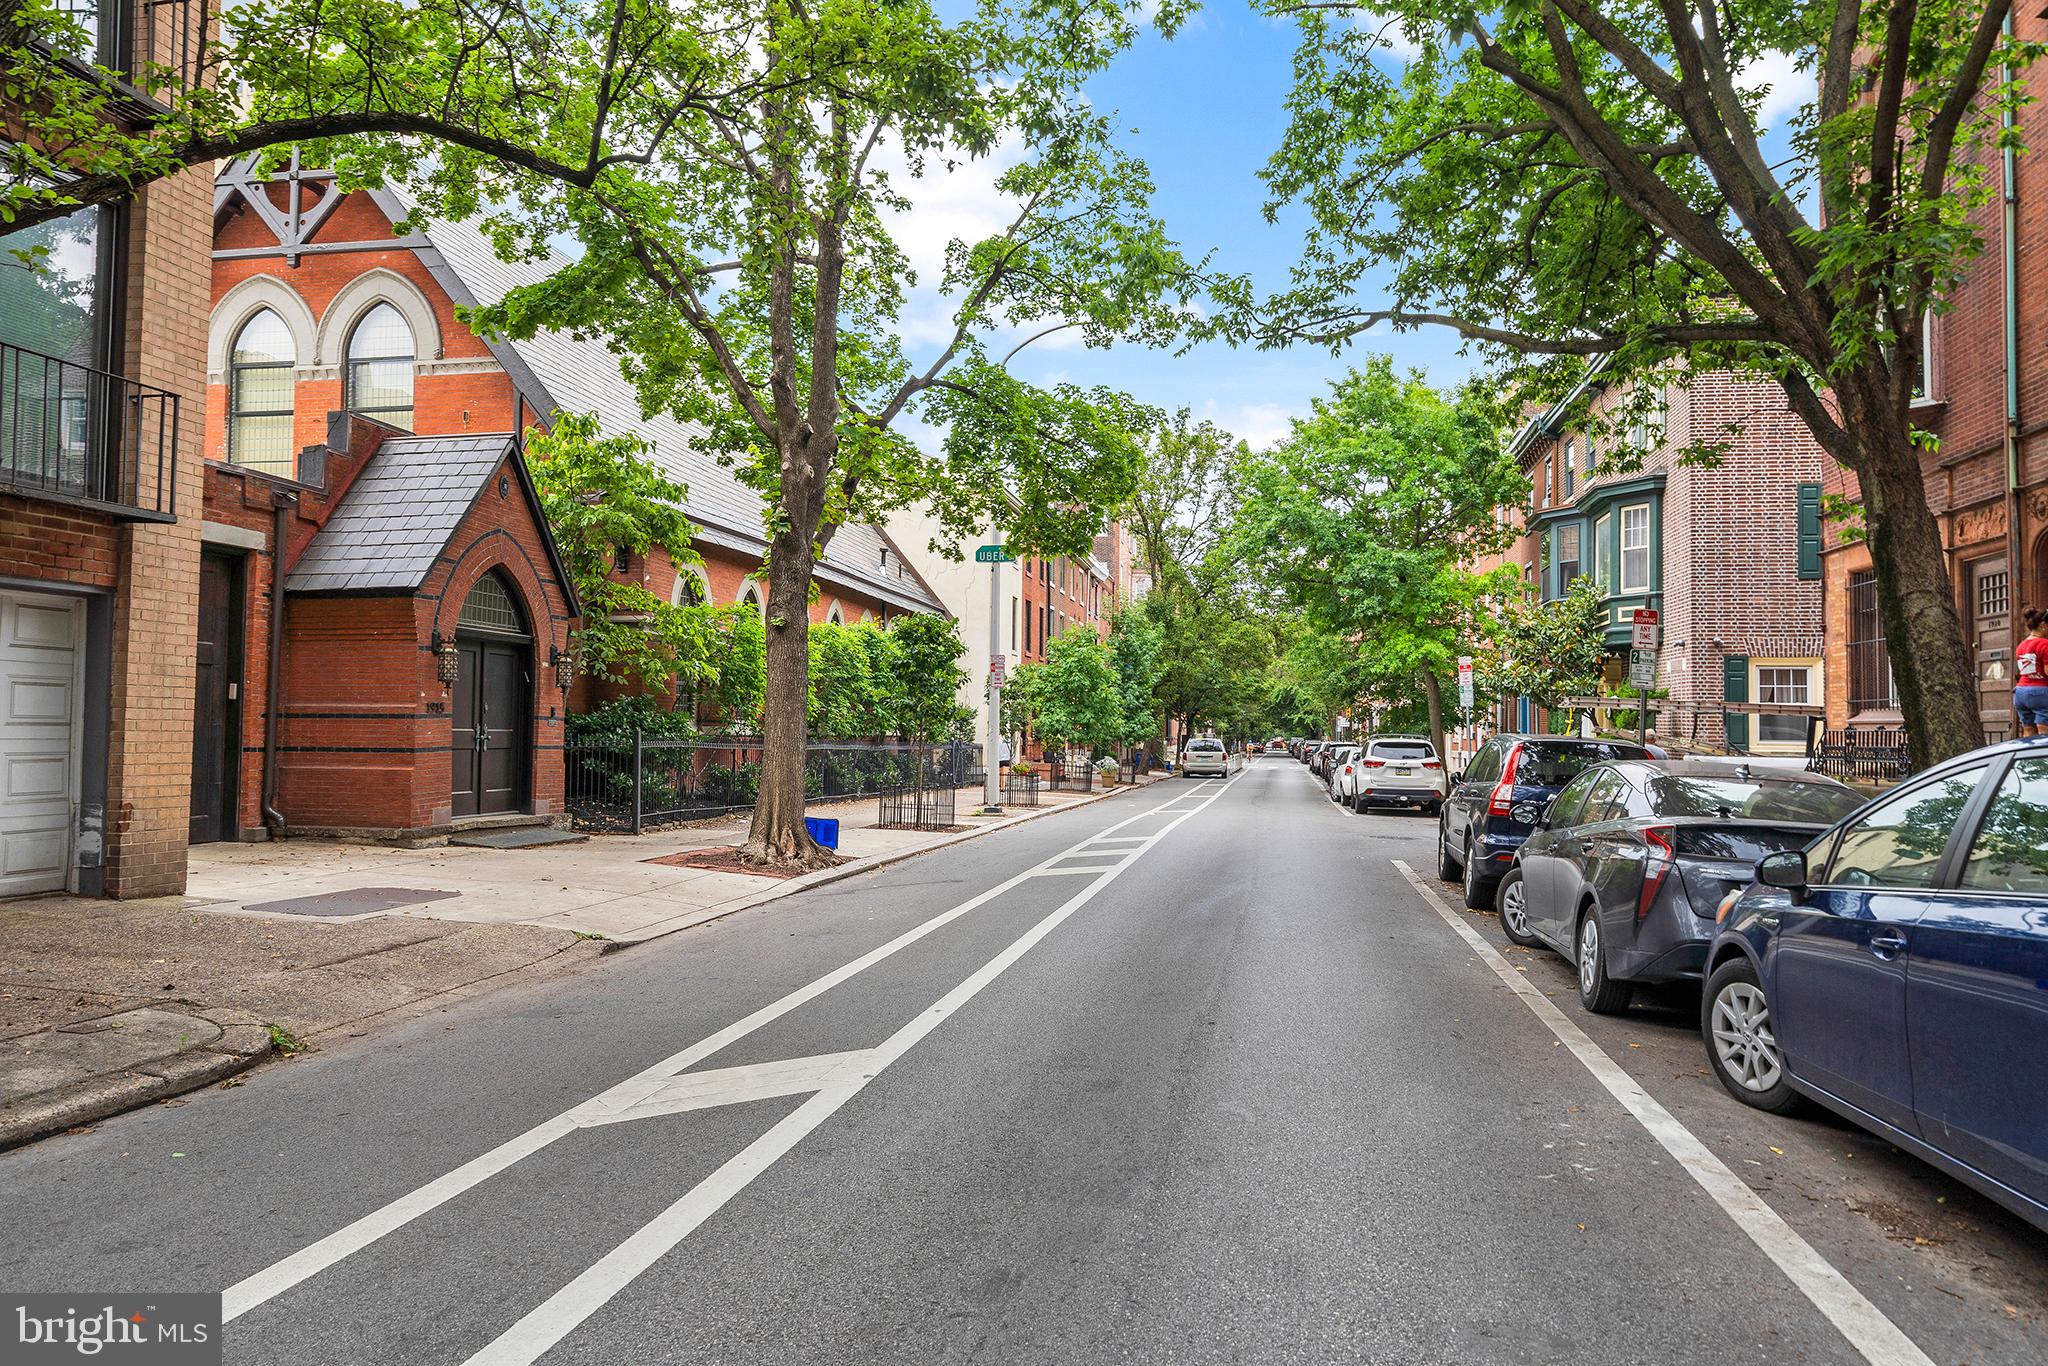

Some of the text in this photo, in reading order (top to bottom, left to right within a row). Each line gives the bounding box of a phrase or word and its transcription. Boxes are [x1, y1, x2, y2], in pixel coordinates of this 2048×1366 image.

[980, 551, 1005, 561] UBER
[1635, 616, 1656, 624] STOPPING
[1640, 632, 1651, 640] TIME
[1632, 651, 1639, 662] 2
